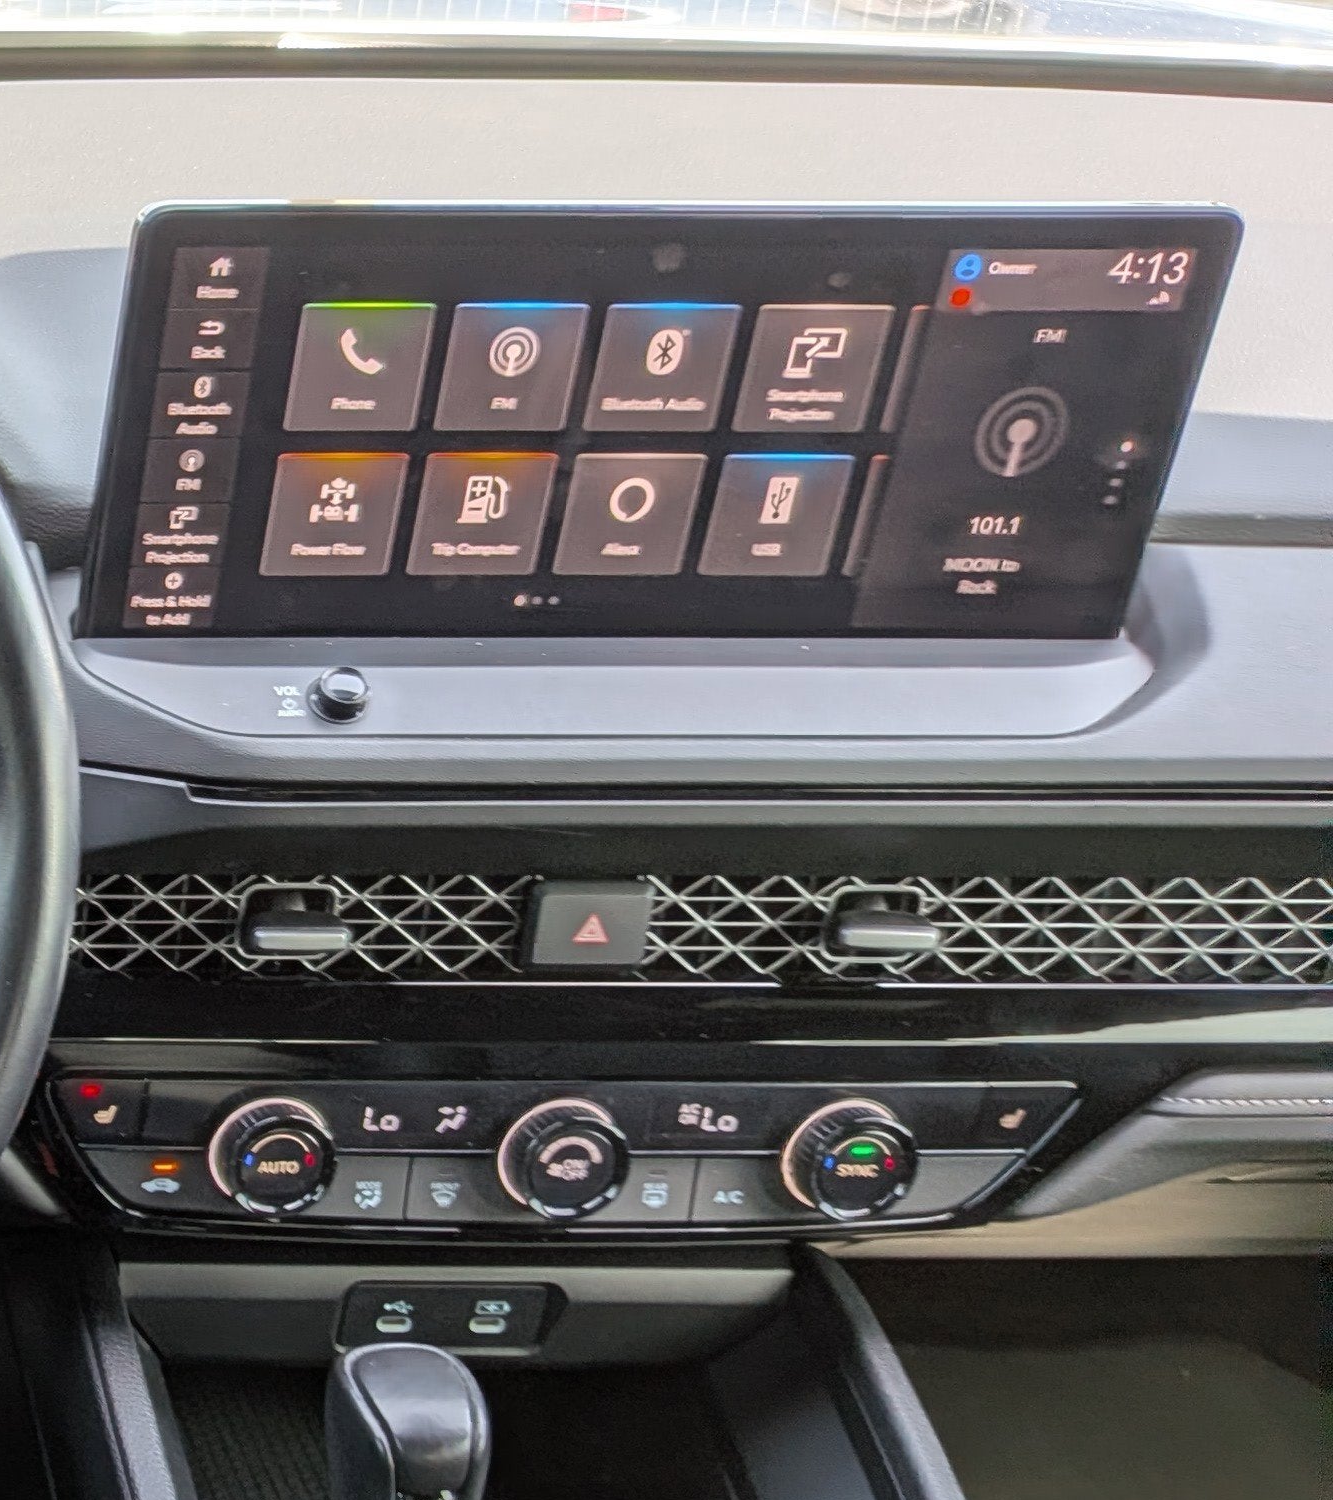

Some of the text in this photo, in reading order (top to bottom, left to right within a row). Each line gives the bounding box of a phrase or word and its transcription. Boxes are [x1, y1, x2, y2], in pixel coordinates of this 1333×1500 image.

[1109, 252, 1190, 285] 4:13
[1033, 327, 1067, 343] FM
[970, 516, 1021, 535] 101.1
[257, 1160, 300, 1174] AUTO
[835, 1163, 880, 1178] SYNC
